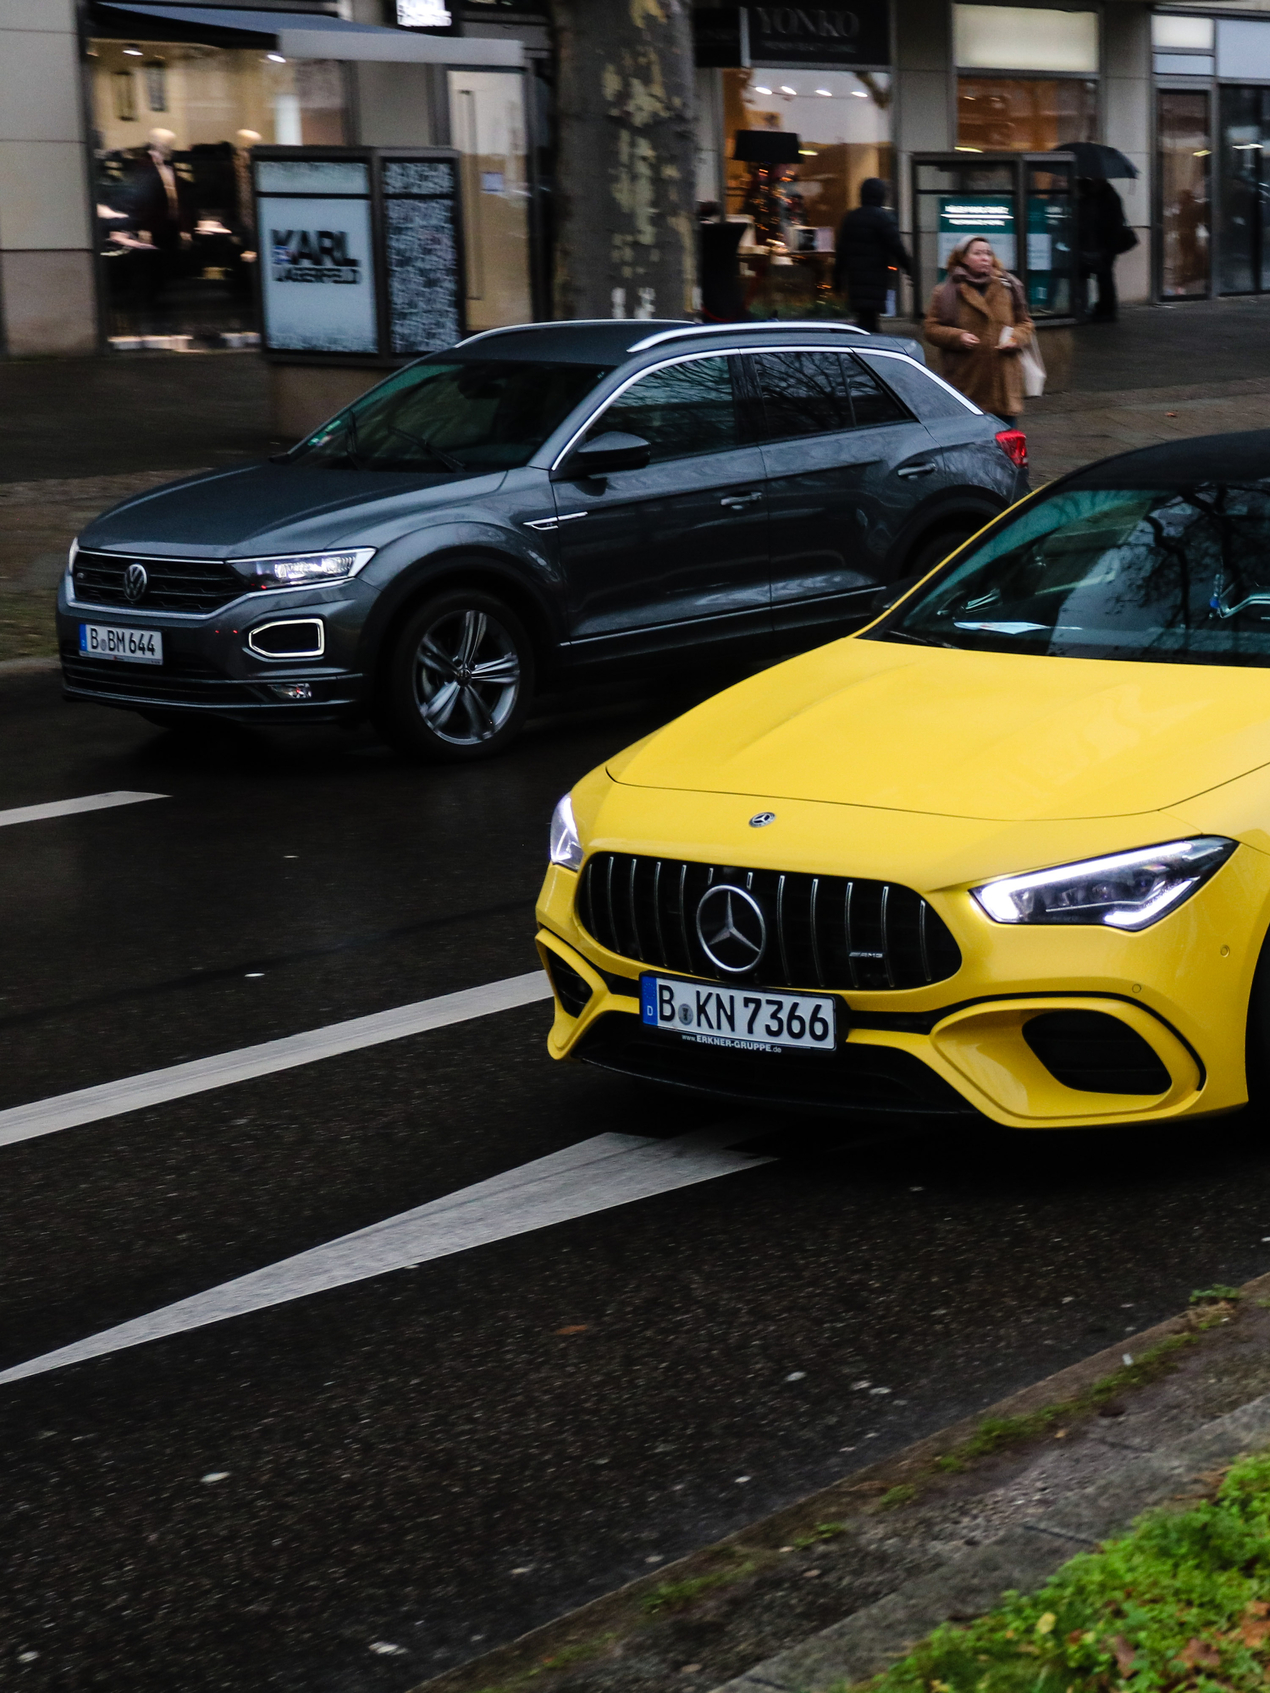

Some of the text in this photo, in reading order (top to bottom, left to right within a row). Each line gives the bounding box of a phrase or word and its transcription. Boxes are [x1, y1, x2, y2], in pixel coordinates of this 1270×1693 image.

[270, 226, 359, 267] KARL
[90, 627, 156, 657] B BM 644
[658, 983, 829, 1042] B KN 7366
